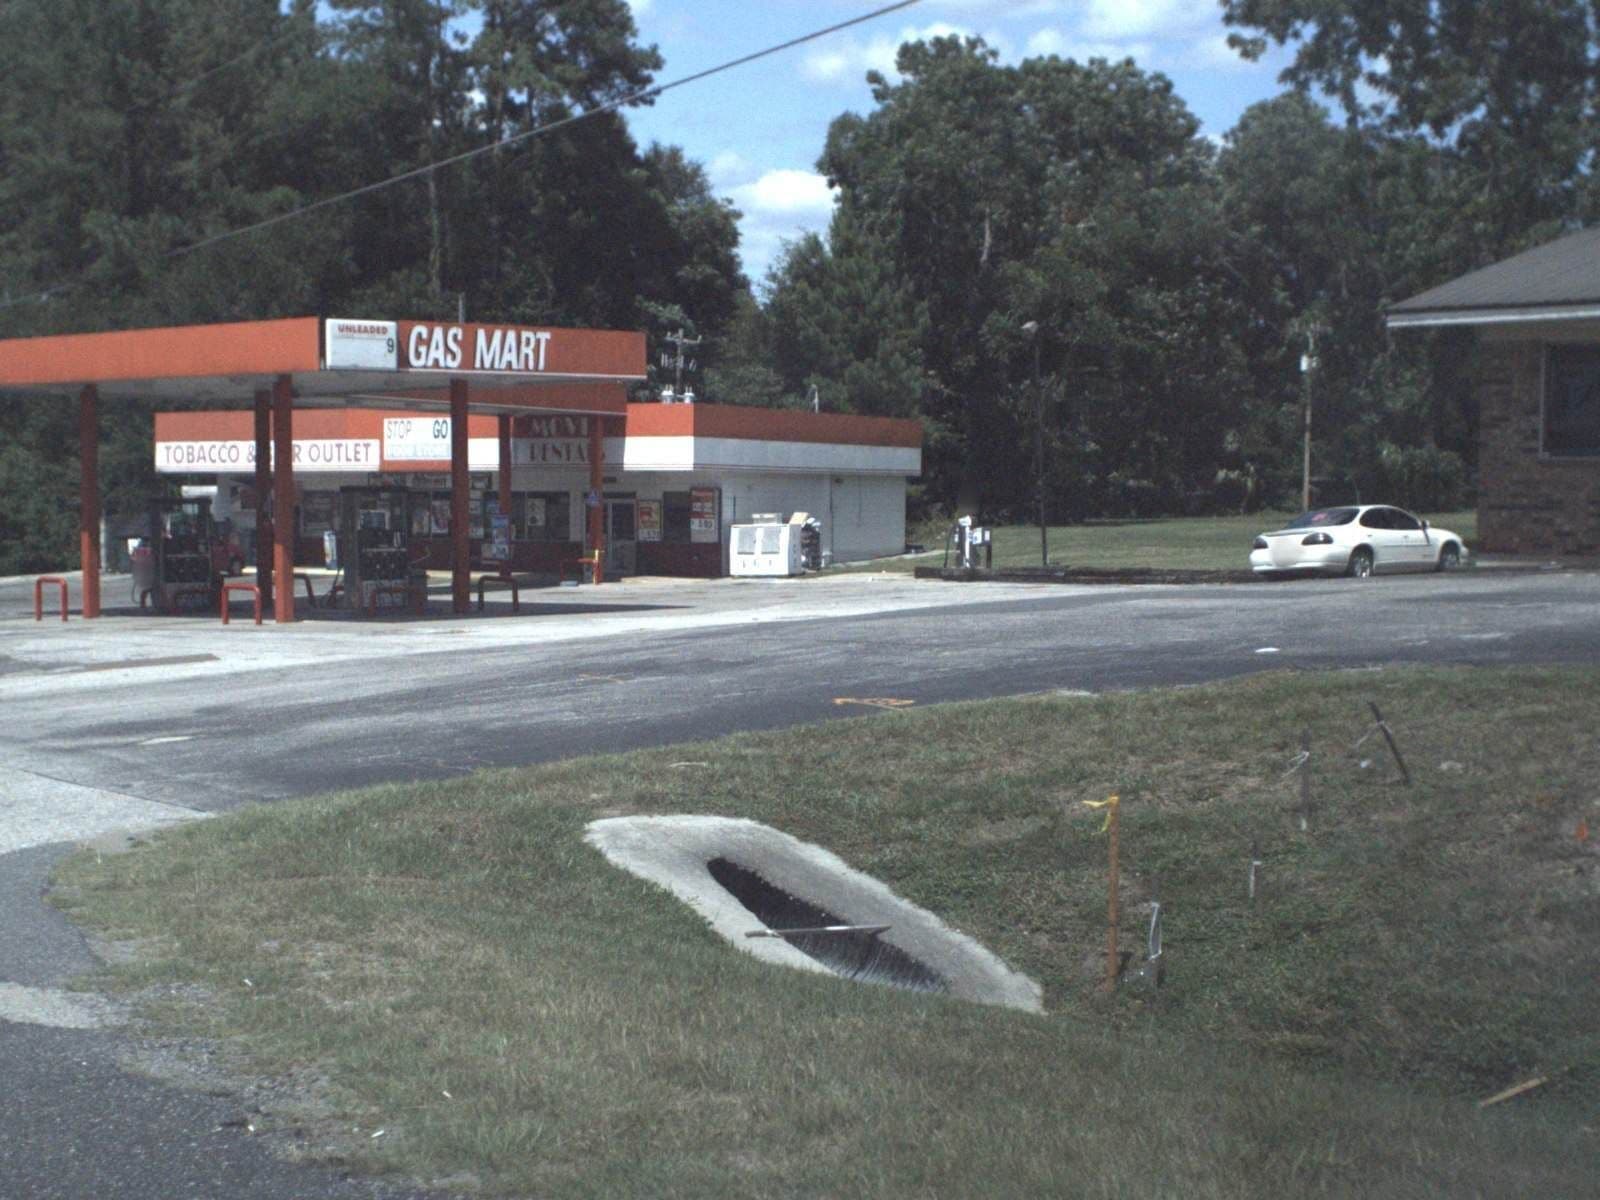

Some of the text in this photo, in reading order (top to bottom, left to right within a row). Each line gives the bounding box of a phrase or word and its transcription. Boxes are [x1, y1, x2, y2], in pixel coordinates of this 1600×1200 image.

[337, 323, 389, 335] UNLEADED
[386, 337, 395, 353] 9
[408, 325, 552, 371] GAS MART
[386, 419, 449, 440] STOP GO
[164, 443, 240, 465] TOBACCO
[308, 442, 372, 464] OUTLET
